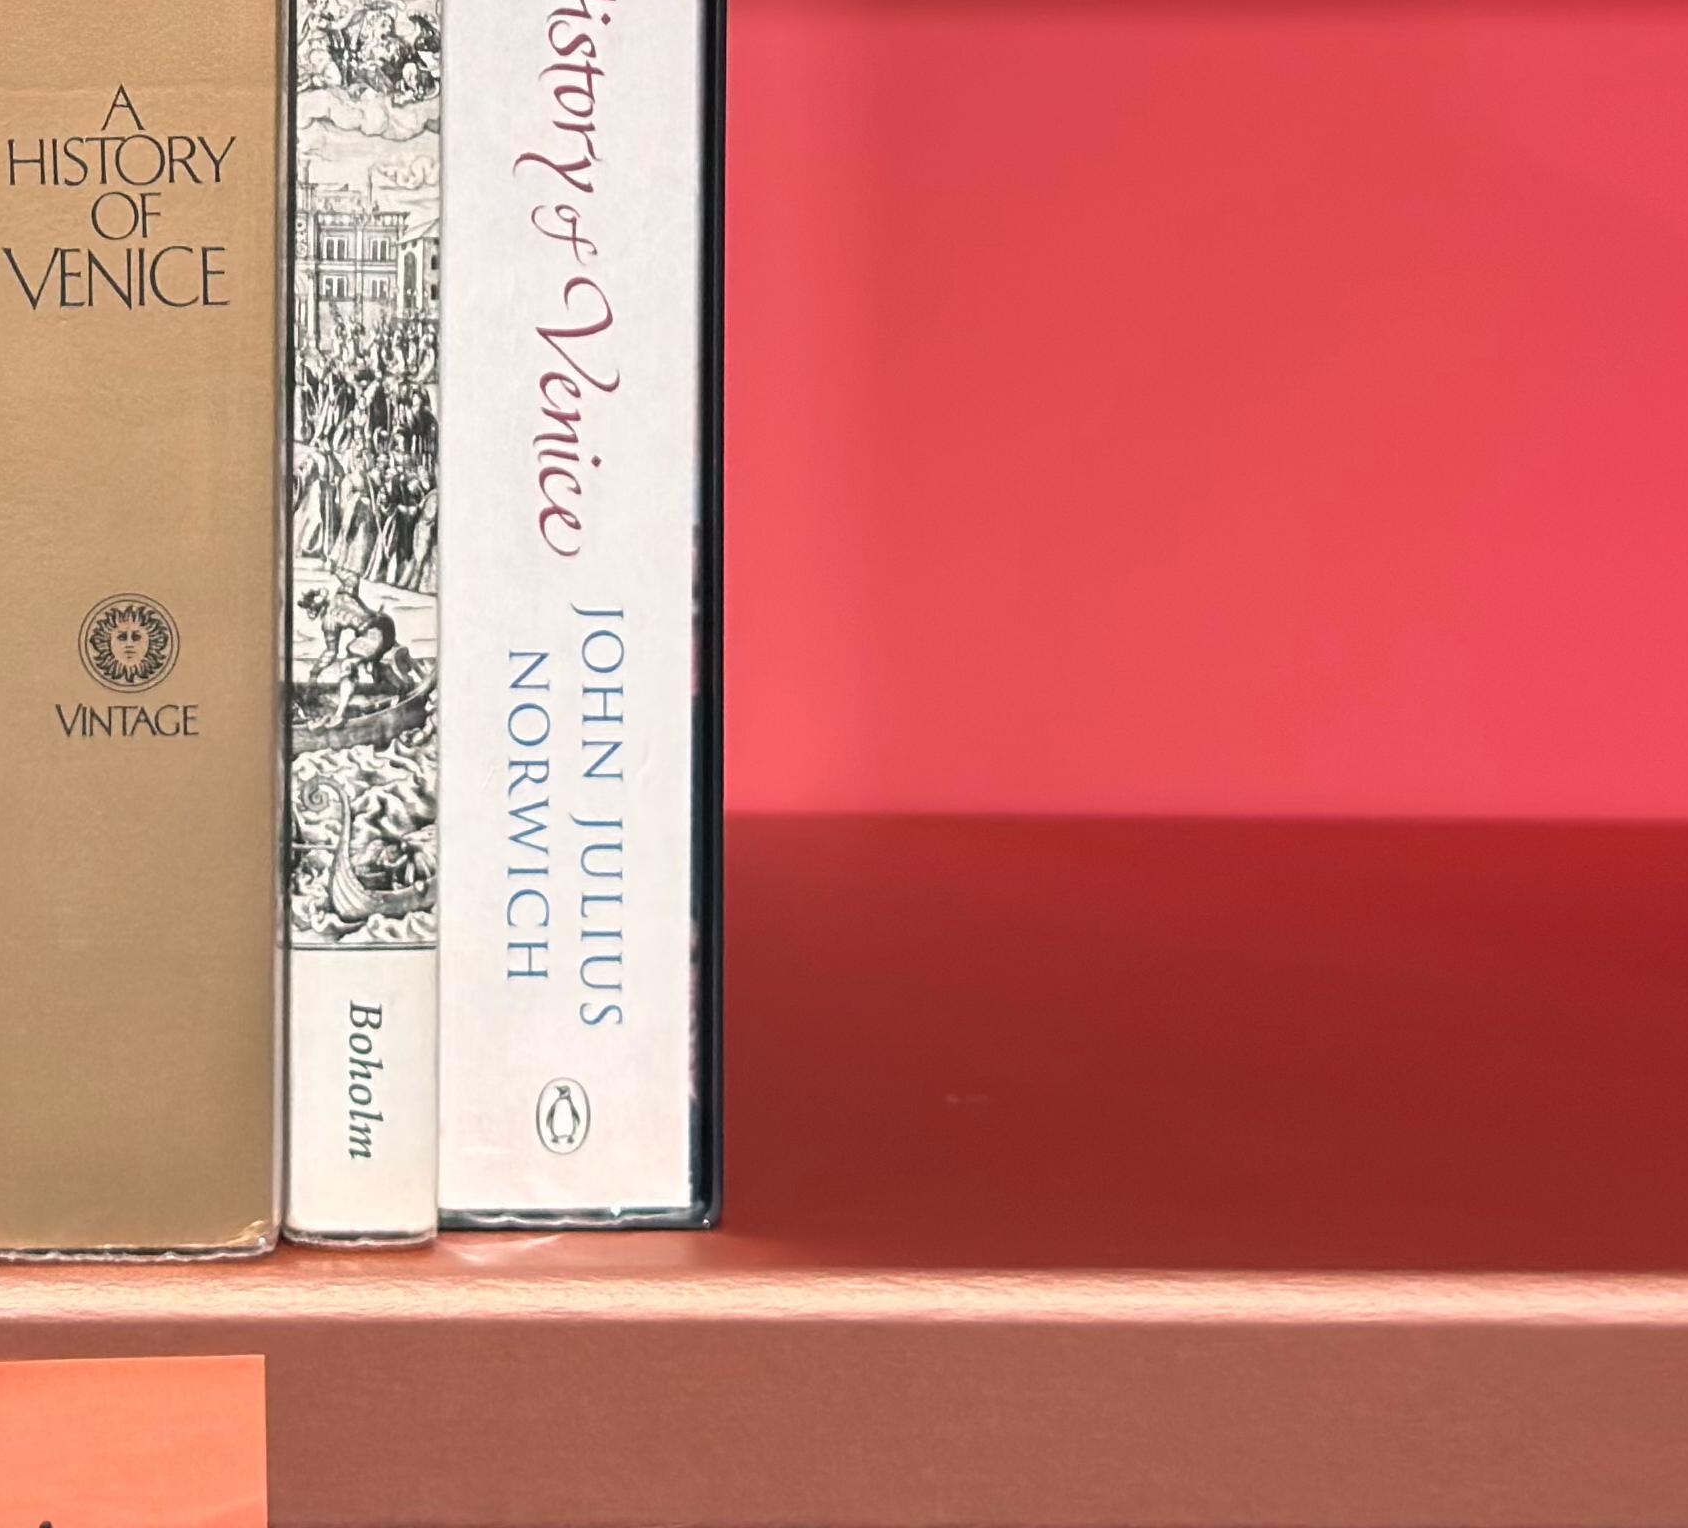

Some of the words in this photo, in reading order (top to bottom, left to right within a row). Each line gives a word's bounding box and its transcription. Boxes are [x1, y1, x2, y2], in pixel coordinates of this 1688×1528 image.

[101, 84, 145, 131] A
[8, 134, 236, 186] HISTORY
[91, 192, 161, 240] OF
[531, 204, 598, 265] of
[2, 246, 230, 310] VENICE
[533, 277, 620, 557] Venice
[55, 703, 198, 737] VINTAGE
[570, 603, 624, 782] JOHN
[507, 651, 550, 980] NORWICH
[569, 814, 623, 1025] JULIUS
[349, 1001, 383, 1158] Boholm
